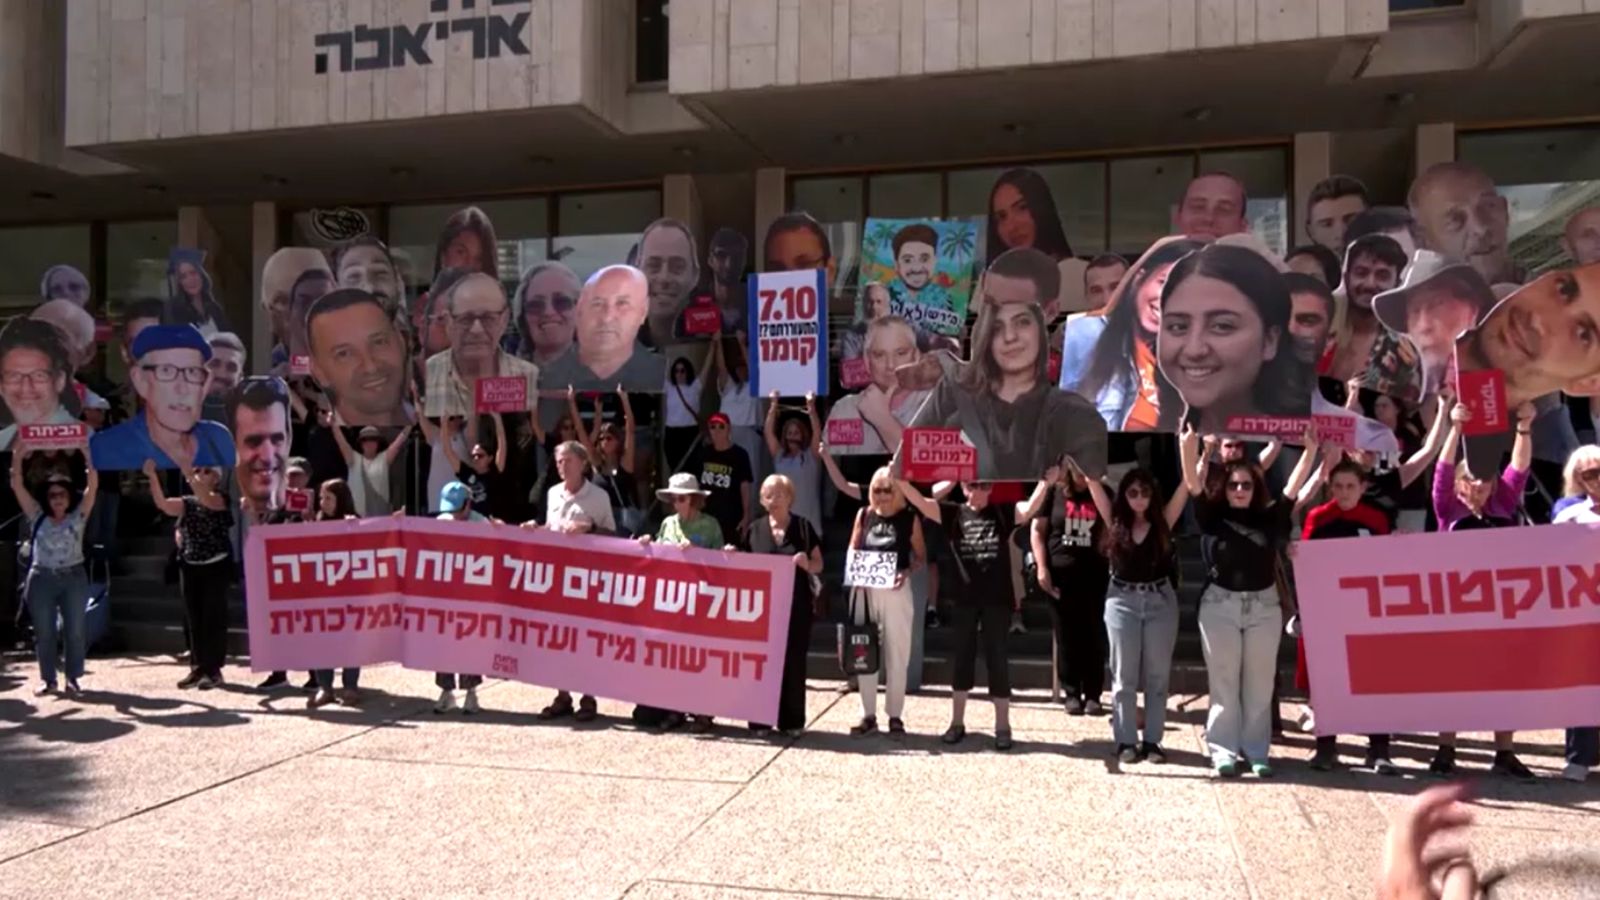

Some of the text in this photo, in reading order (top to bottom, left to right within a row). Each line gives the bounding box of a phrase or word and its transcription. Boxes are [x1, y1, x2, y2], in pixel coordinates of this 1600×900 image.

[315, 12, 531, 74] אריאלה
[759, 286, 816, 321] 7.10
[761, 337, 816, 366] קומו
[29, 424, 82, 437] הביתה
[915, 432, 964, 446] ופקרו
[913, 449, 972, 462] למותם.
[272, 547, 764, 622] שלוש שנים של טיוח הפקרה
[1339, 562, 1600, 620] אוקטובר
[403, 605, 502, 640] חקירה
[508, 616, 578, 652] ועדת
[587, 629, 636, 663] מיד
[644, 639, 768, 681] דורשות
